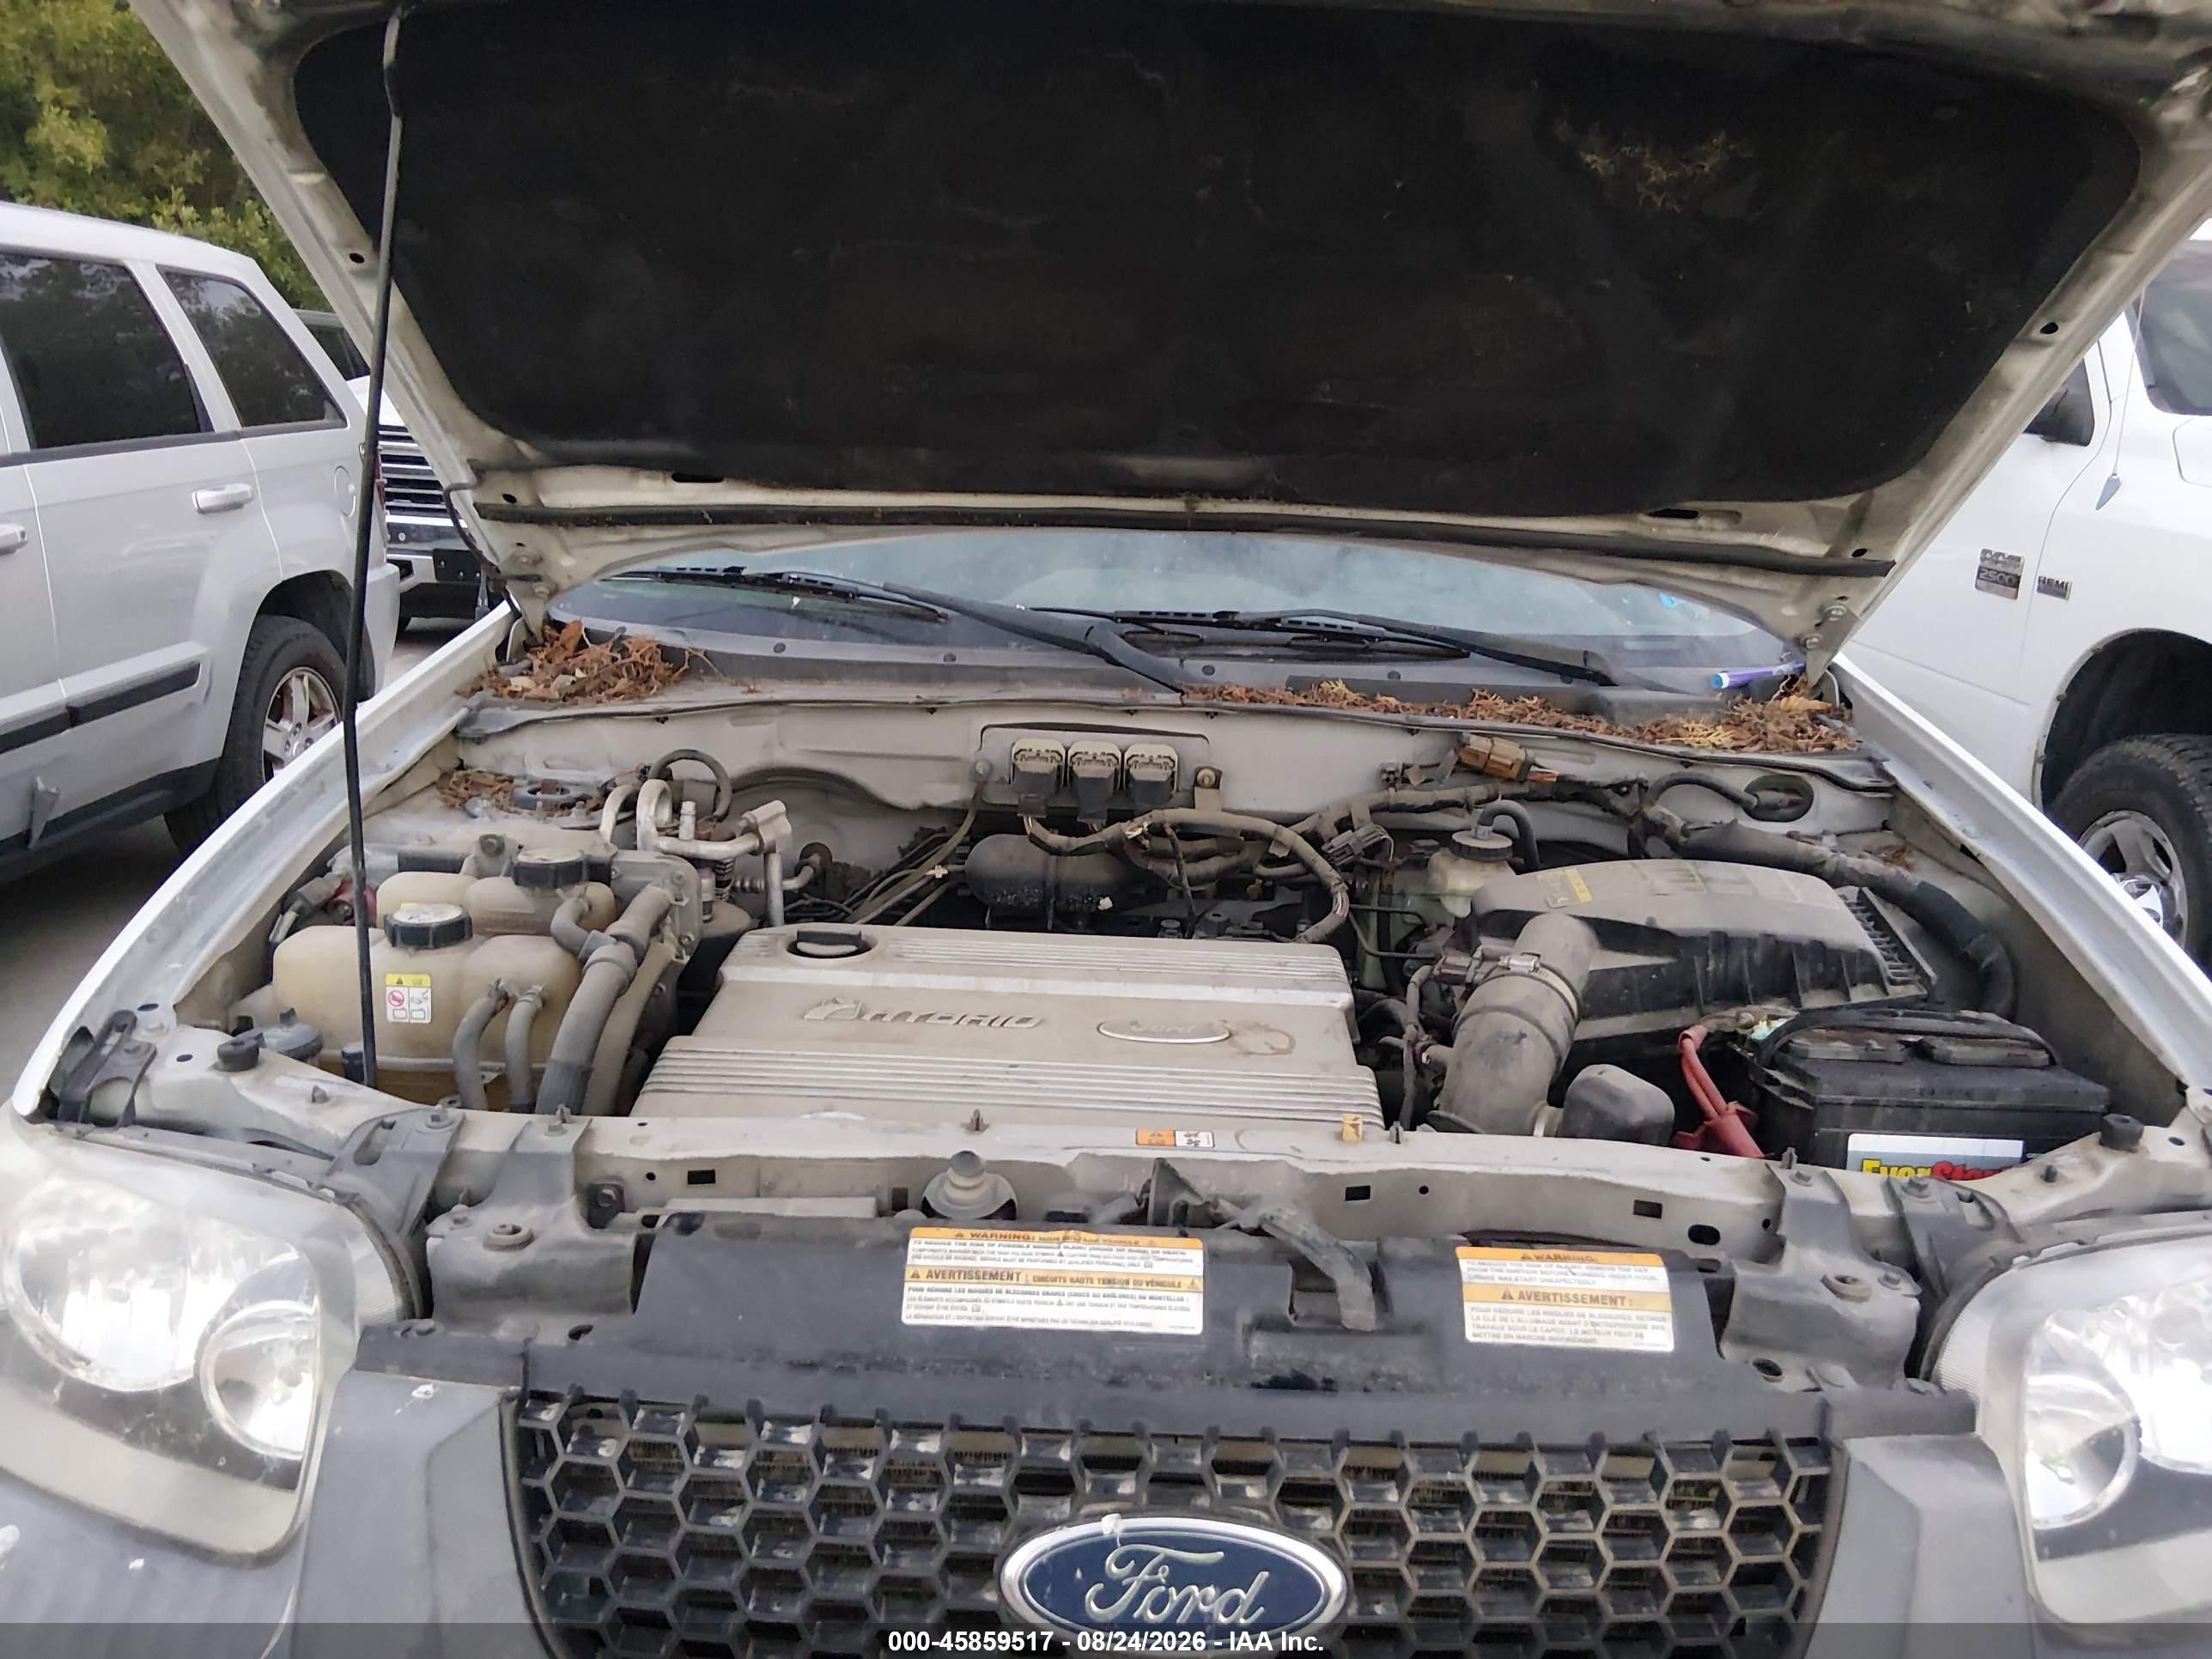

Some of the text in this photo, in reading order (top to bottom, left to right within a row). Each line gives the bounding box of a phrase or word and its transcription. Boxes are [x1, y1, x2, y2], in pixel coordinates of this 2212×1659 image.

[1979, 568, 2015, 586] 2500
[2038, 575, 2069, 591] HEMI
[926, 1269, 1022, 1282] AVERTISSEMENT
[1033, 1274, 1066, 1284] CIRCUITS
[1069, 1276, 1094, 1285] HAUTE
[1097, 1277, 1130, 1285] TENSION
[1518, 1291, 1626, 1306] AVERTISSEMENT
[1085, 1544, 1270, 1625] Ford
